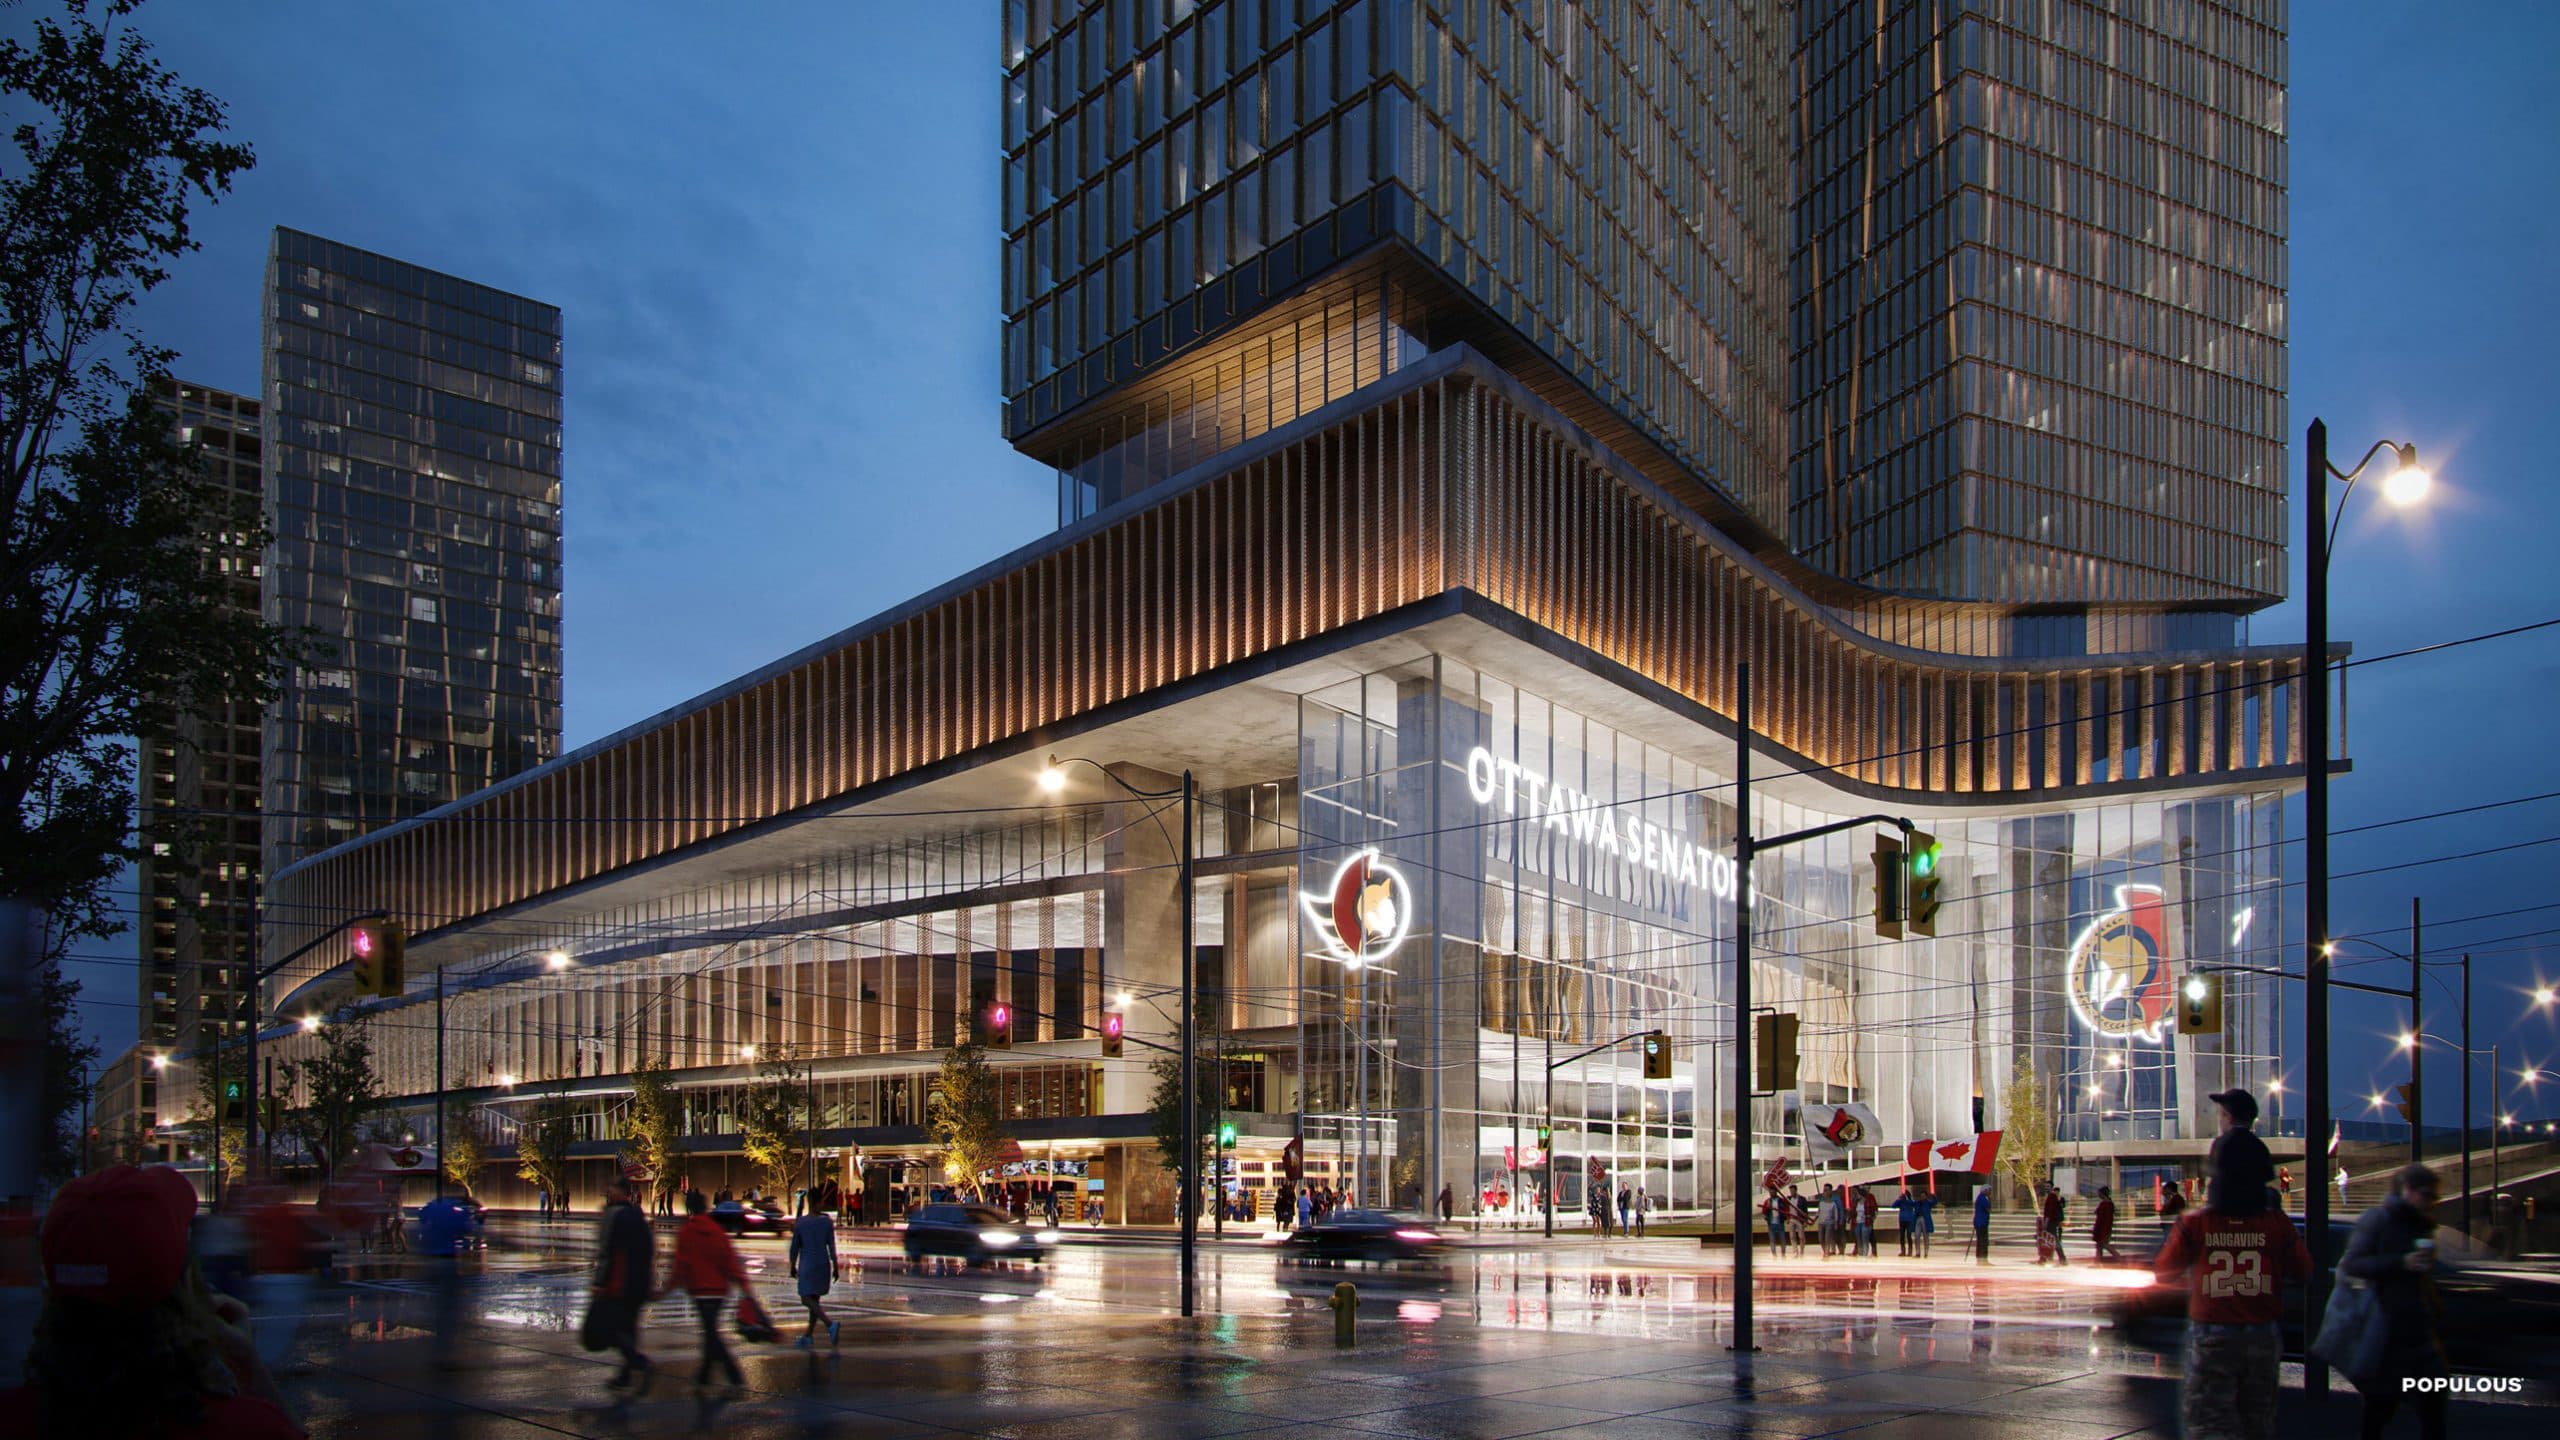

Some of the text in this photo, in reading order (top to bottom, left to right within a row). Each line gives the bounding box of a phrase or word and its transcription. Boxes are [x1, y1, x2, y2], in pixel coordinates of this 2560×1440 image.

[1468, 746, 1755, 908] OTTAWA SENATO
[2205, 1232, 2266, 1247] DAUGAVINS
[2208, 1250, 2262, 1298] 23
